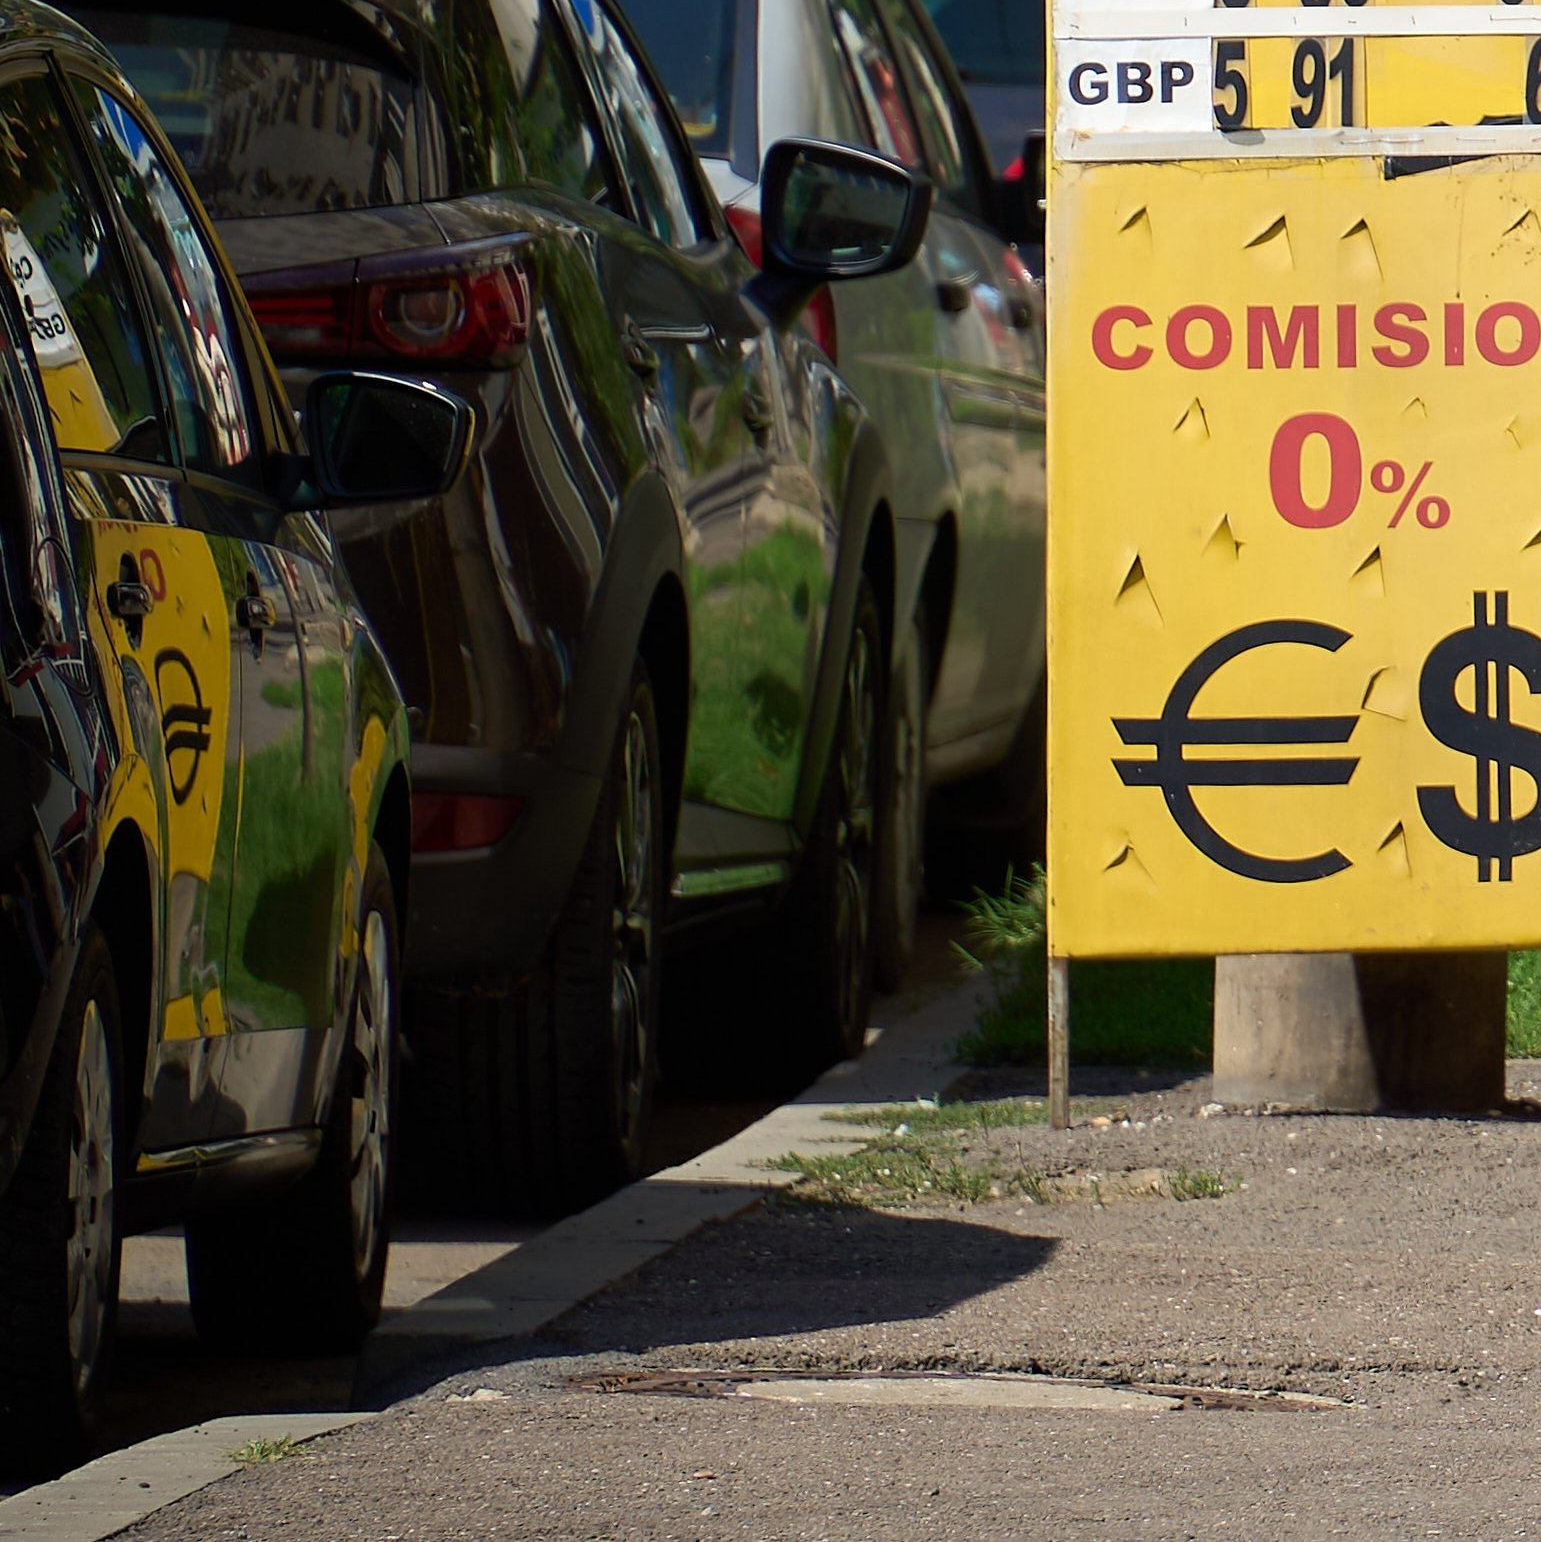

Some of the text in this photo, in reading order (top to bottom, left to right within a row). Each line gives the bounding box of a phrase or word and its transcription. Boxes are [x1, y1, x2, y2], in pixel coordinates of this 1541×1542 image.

[1068, 60, 1195, 106] GBP
[1213, 40, 1249, 130] 5
[1291, 37, 1356, 130] 91
[1268, 411, 1452, 531] 0%
